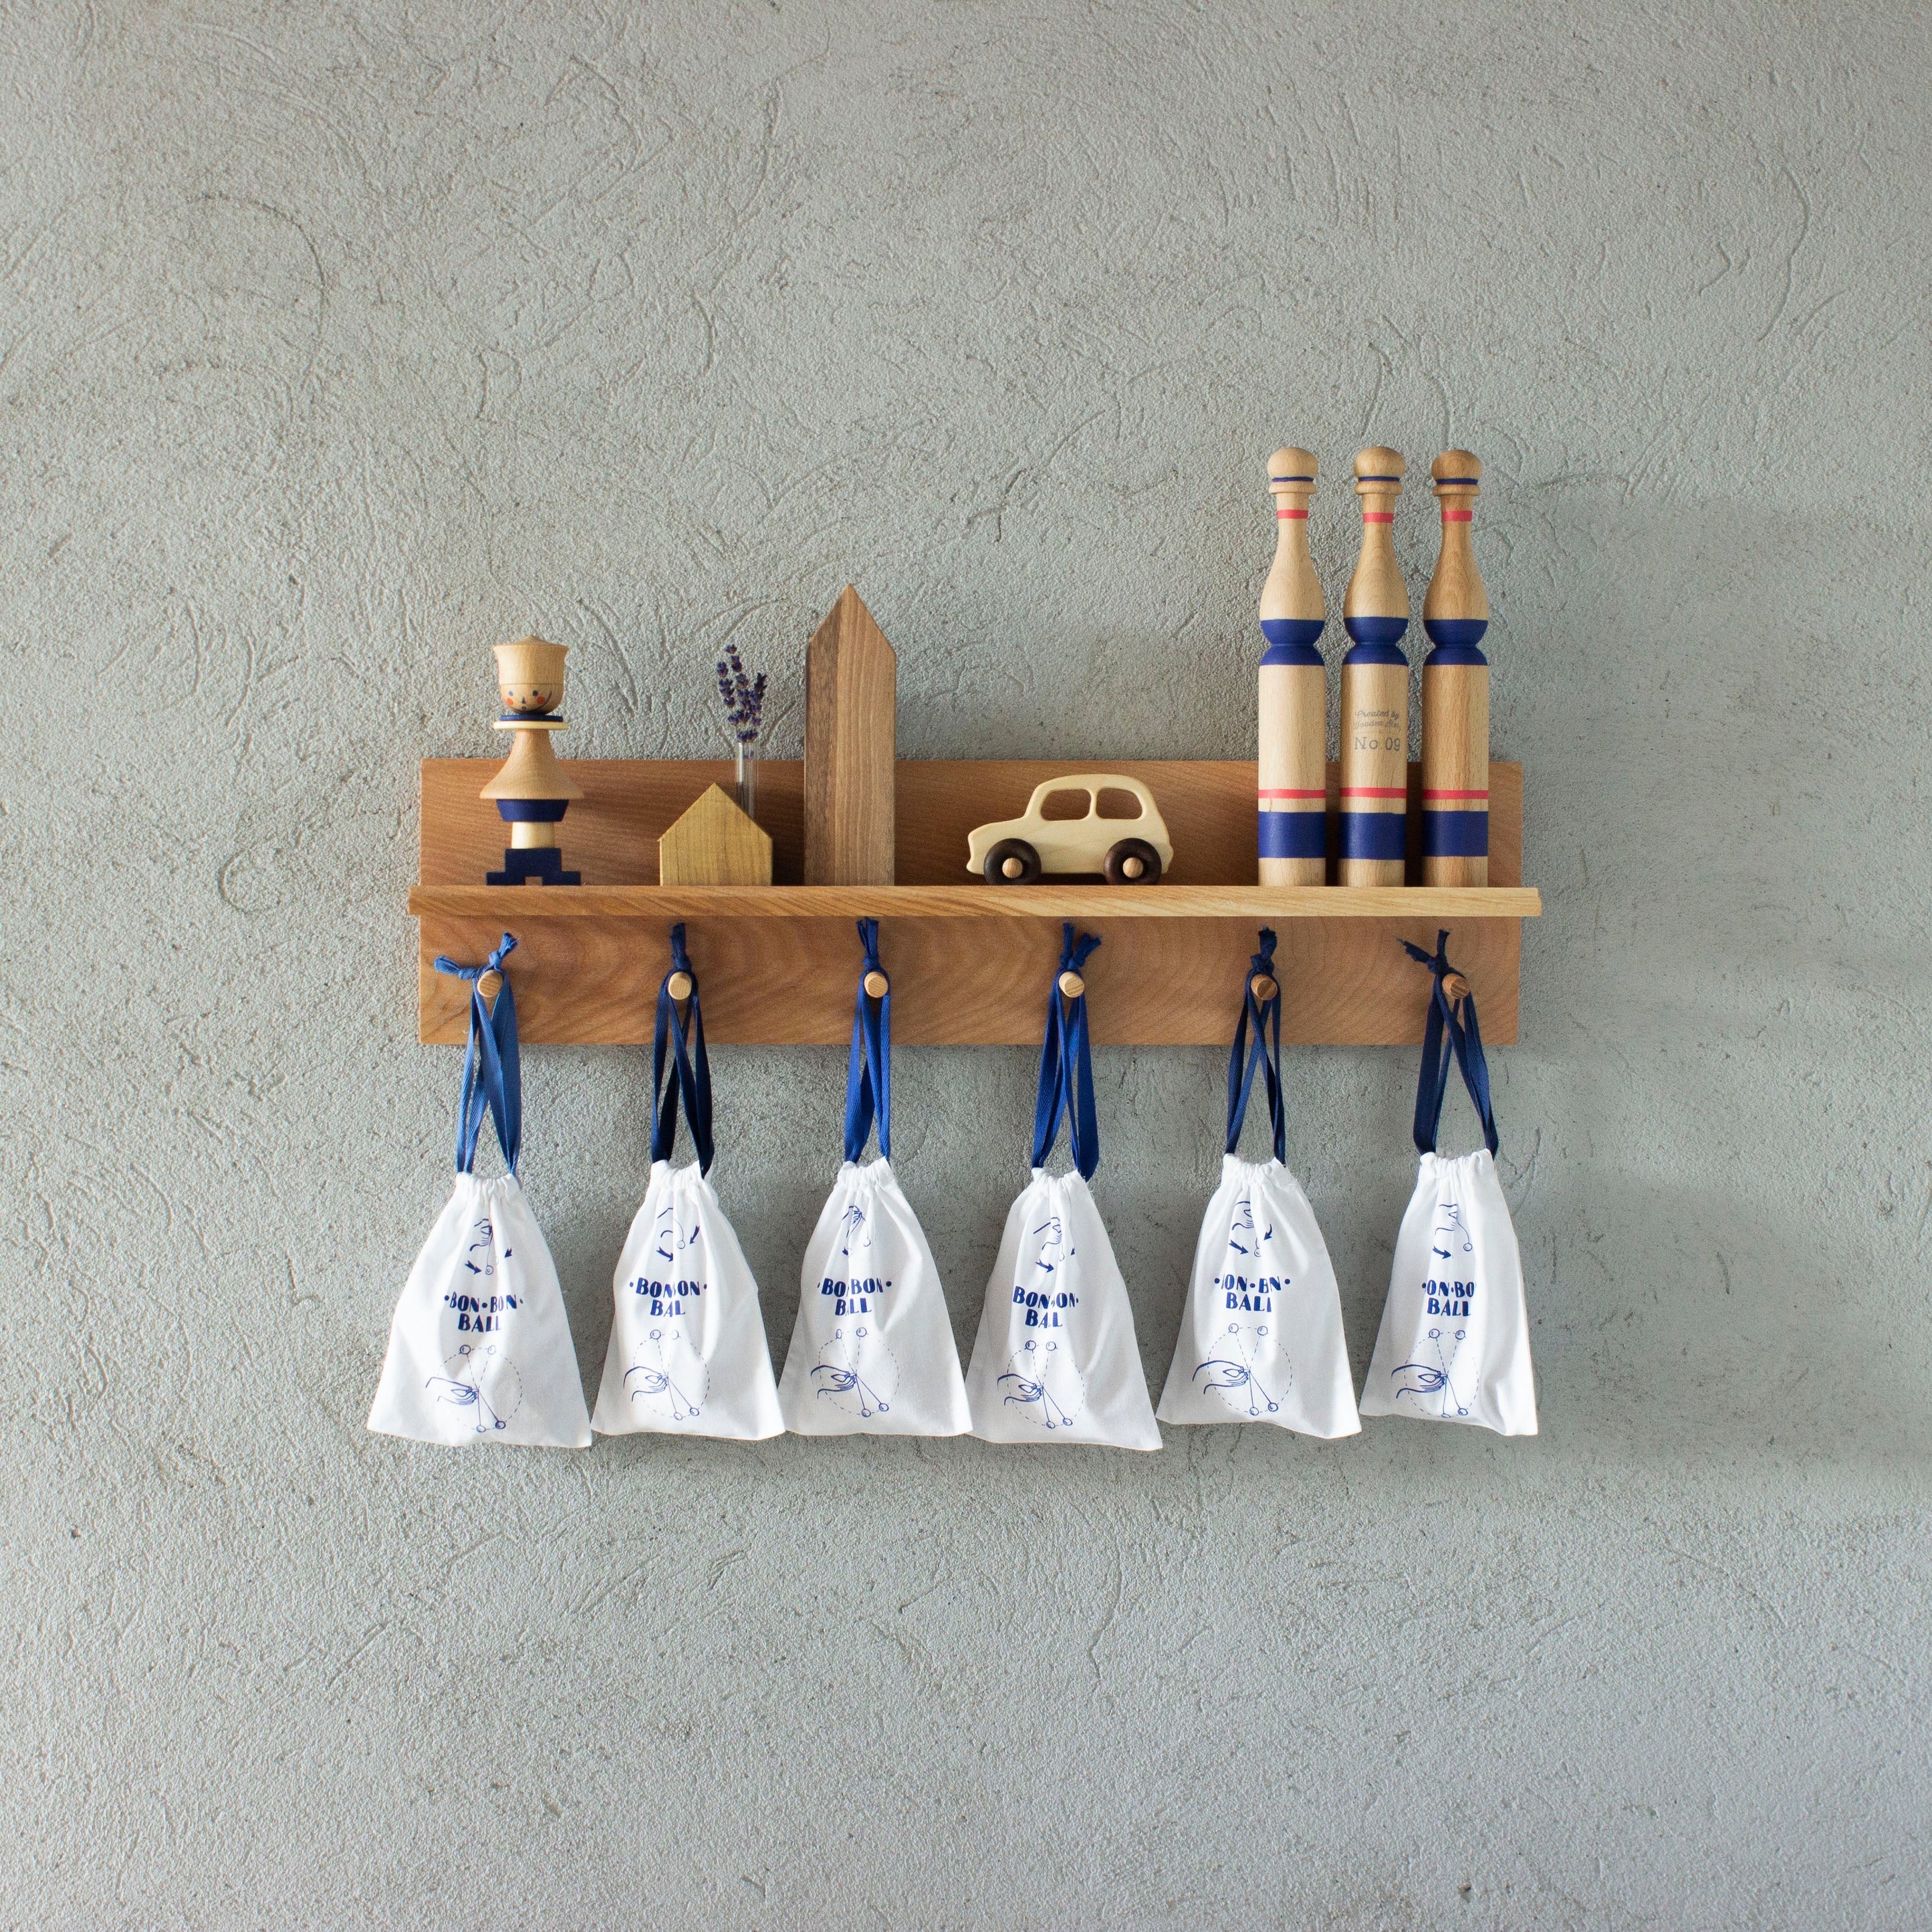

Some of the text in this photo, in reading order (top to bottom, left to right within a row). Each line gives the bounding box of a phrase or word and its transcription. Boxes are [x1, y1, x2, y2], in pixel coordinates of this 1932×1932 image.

[1354, 710, 1400, 720] Created by
[1427, 1297, 1471, 1317] BALL
[458, 1313, 502, 1333] BALL
